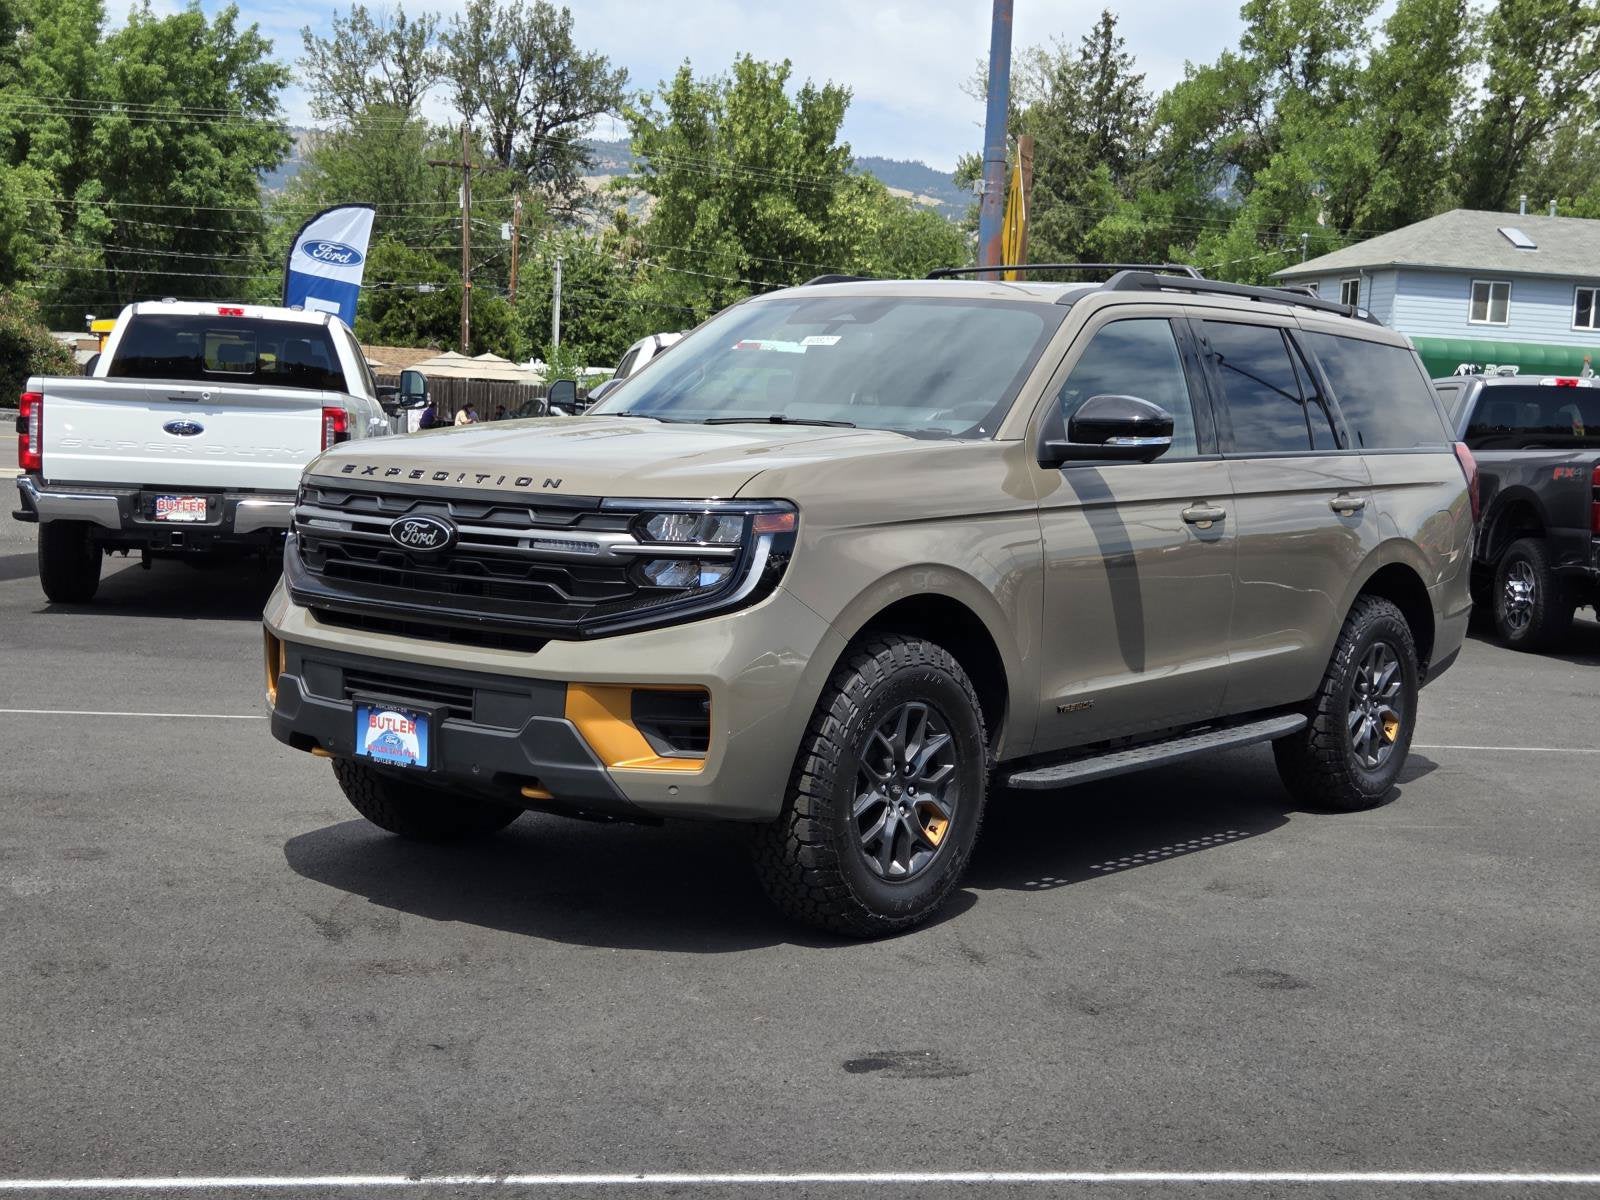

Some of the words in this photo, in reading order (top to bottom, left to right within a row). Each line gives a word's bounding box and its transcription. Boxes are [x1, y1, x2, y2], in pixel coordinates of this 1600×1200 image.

[313, 243, 352, 264] Ford
[59, 437, 193, 454] SUPER
[204, 442, 305, 458] DUTY
[341, 464, 562, 489] EXPEDITION
[1552, 467, 1583, 480] FX4
[157, 499, 206, 512] BUTLER
[400, 521, 438, 546] Ford
[369, 714, 416, 734] BUTLER
